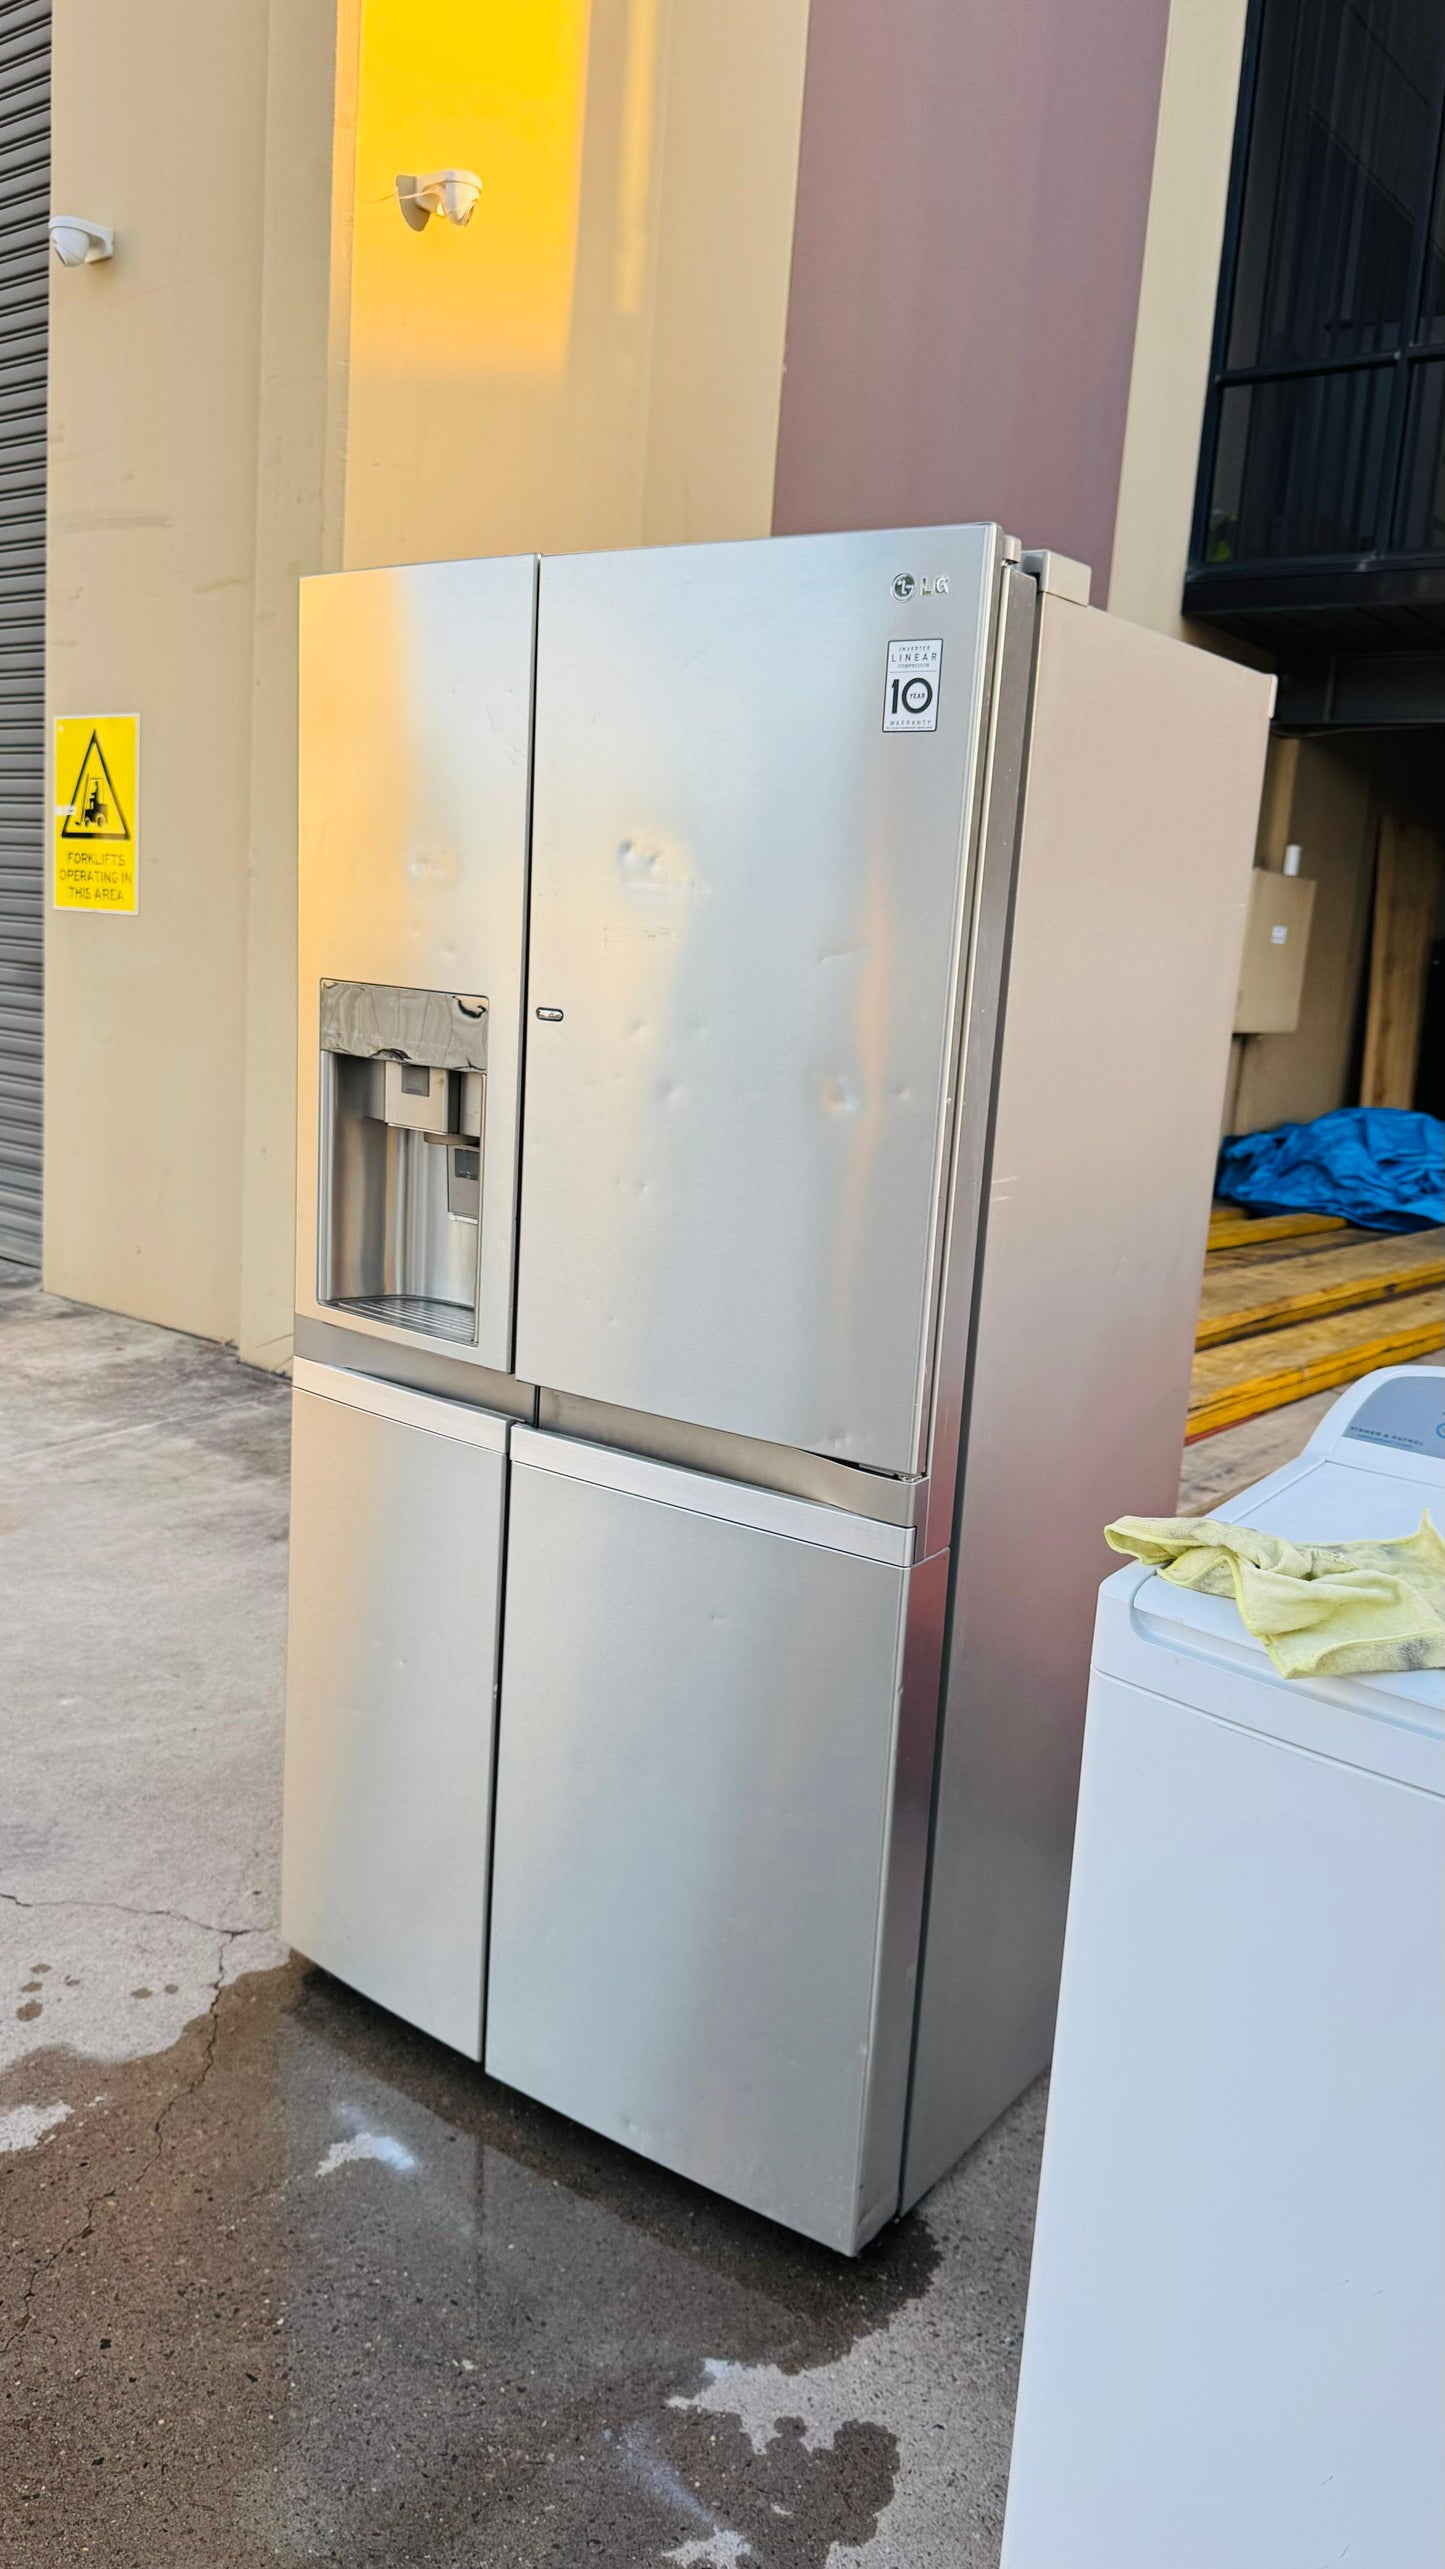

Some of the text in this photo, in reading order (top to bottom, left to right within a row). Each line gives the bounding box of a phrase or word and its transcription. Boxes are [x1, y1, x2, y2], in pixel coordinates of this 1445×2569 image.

[920, 577, 949, 595] LG
[892, 653, 937, 662] LINEAR
[891, 677, 933, 714] 10
[67, 852, 125, 866] FORKLIFTS
[60, 869, 133, 884] OPERATING IN
[69, 886, 124, 901] THIS AREA
